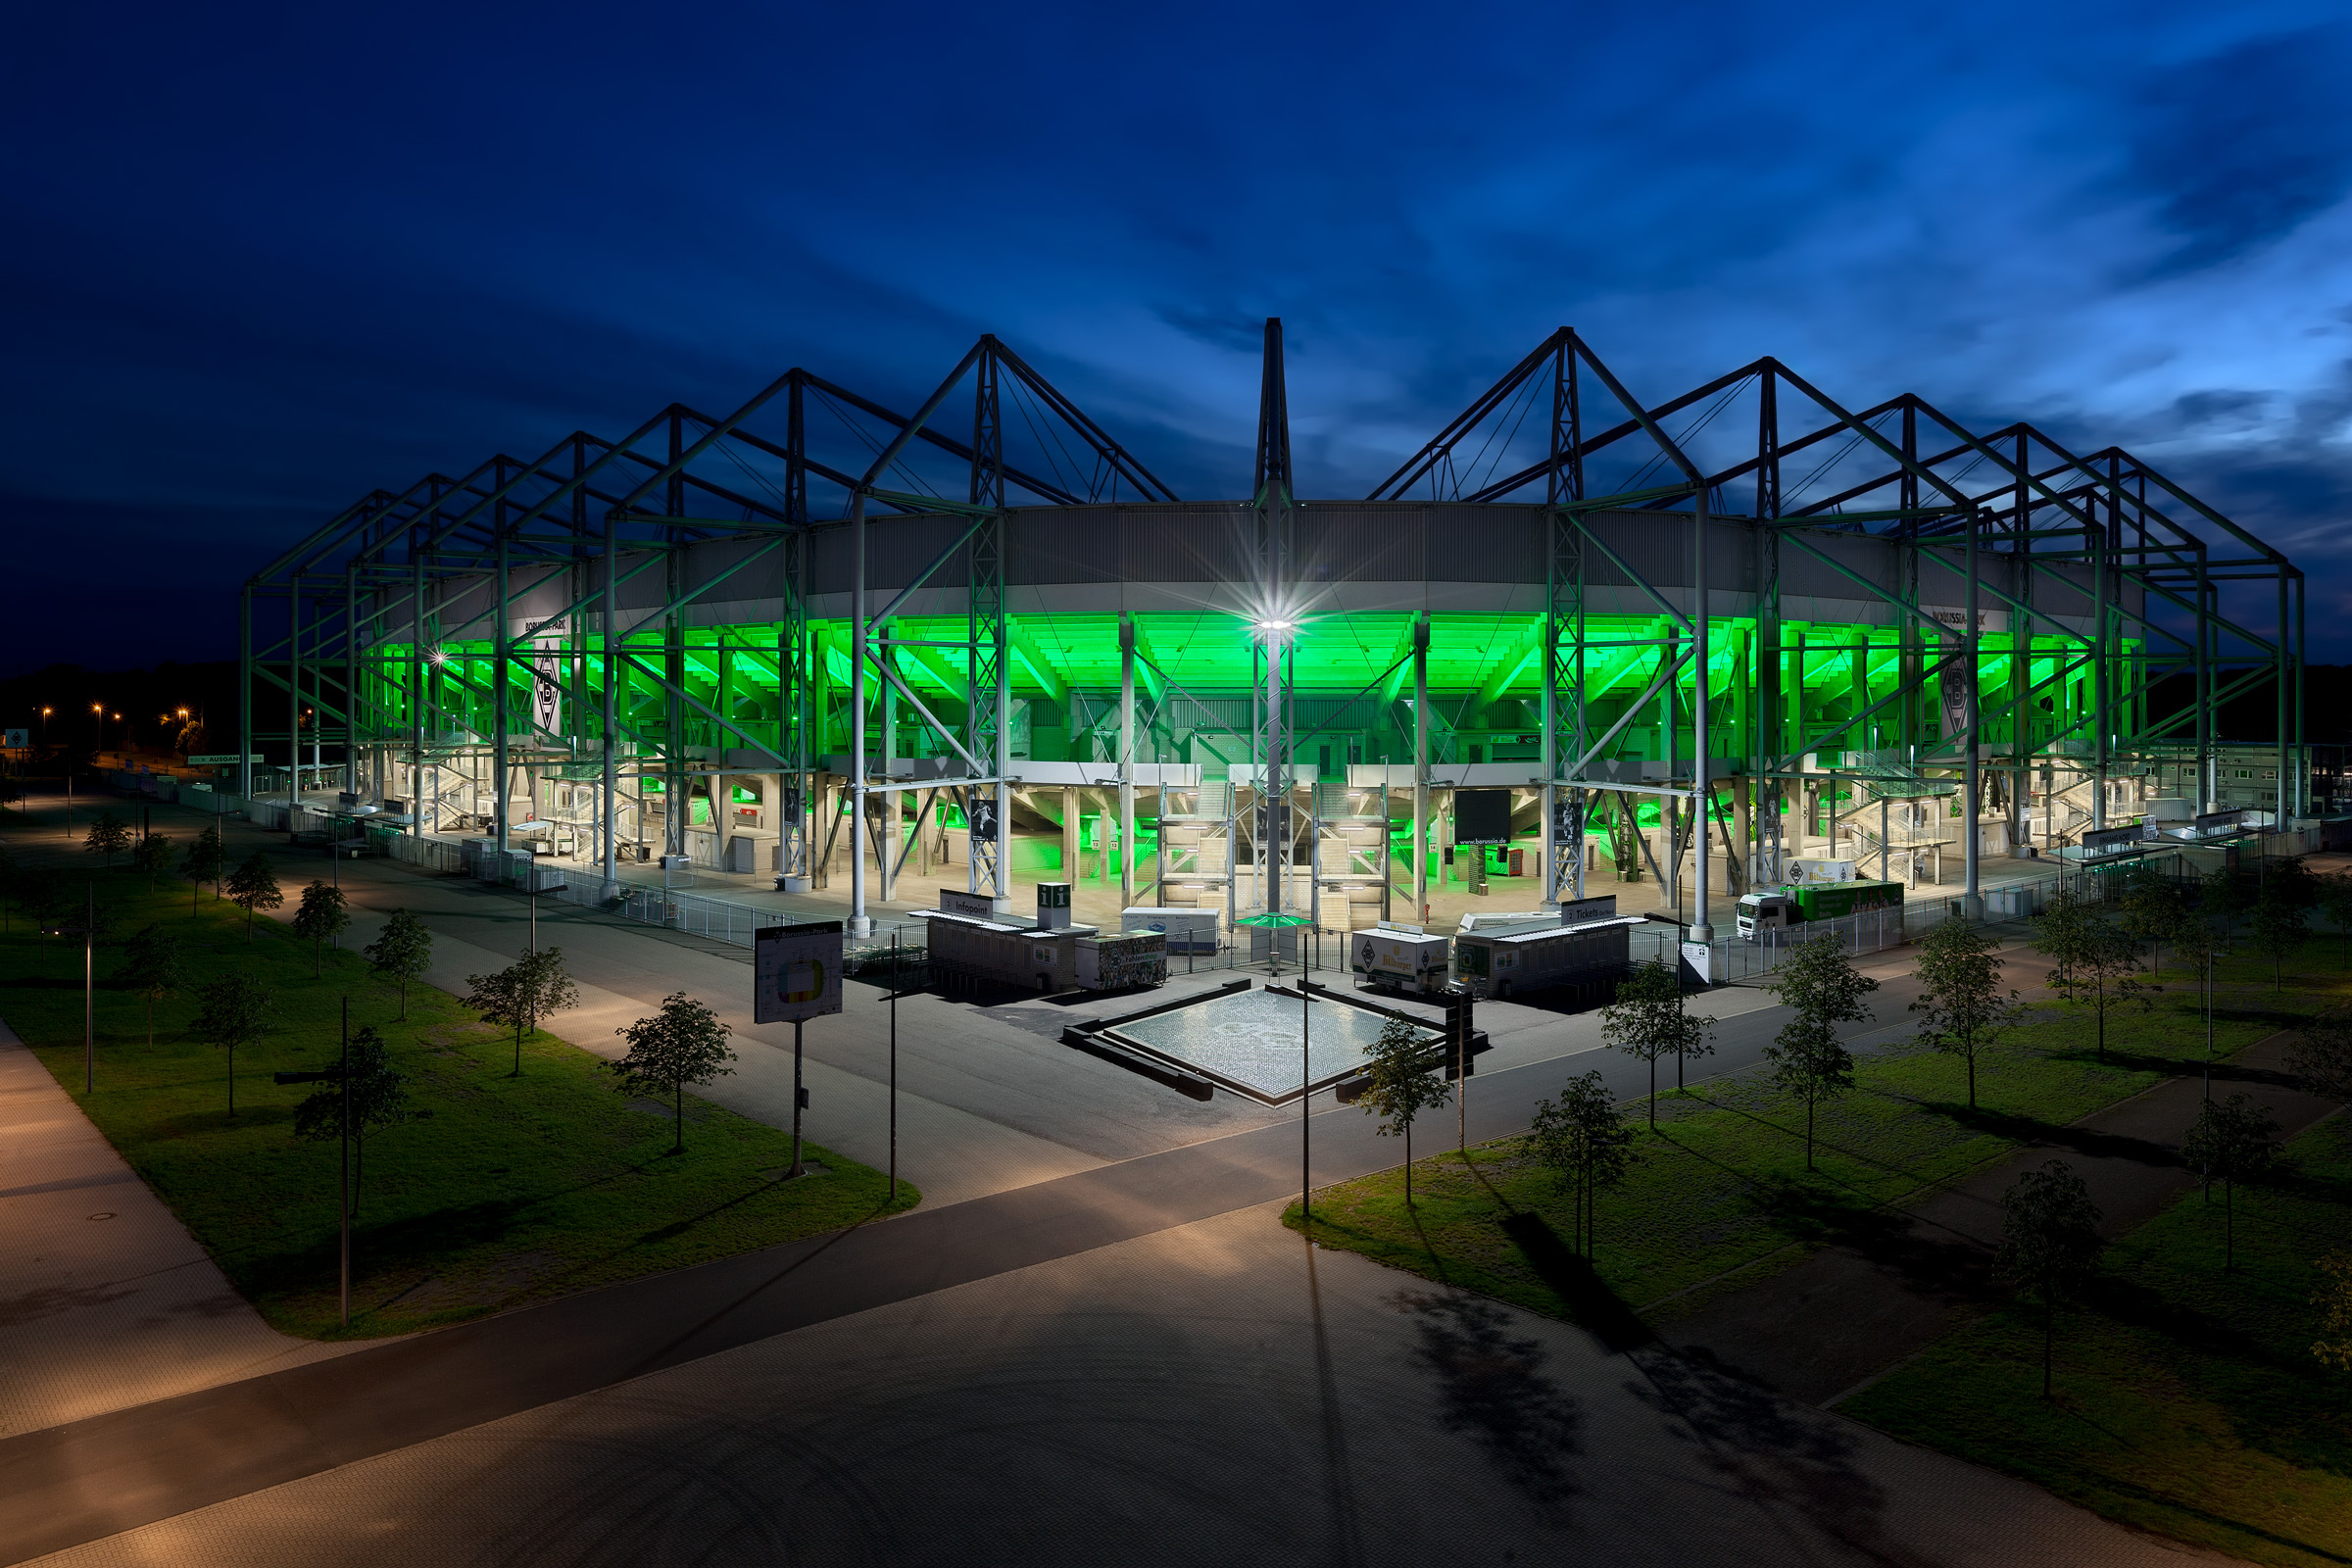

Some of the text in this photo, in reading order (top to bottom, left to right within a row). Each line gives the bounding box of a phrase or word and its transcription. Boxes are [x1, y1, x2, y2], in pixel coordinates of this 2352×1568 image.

[2099, 833, 2132, 845] EINGANG NORD
[956, 901, 988, 914] Infopoint
[1576, 907, 1598, 920] Tickets
[781, 928, 828, 938] Borussia-Park
